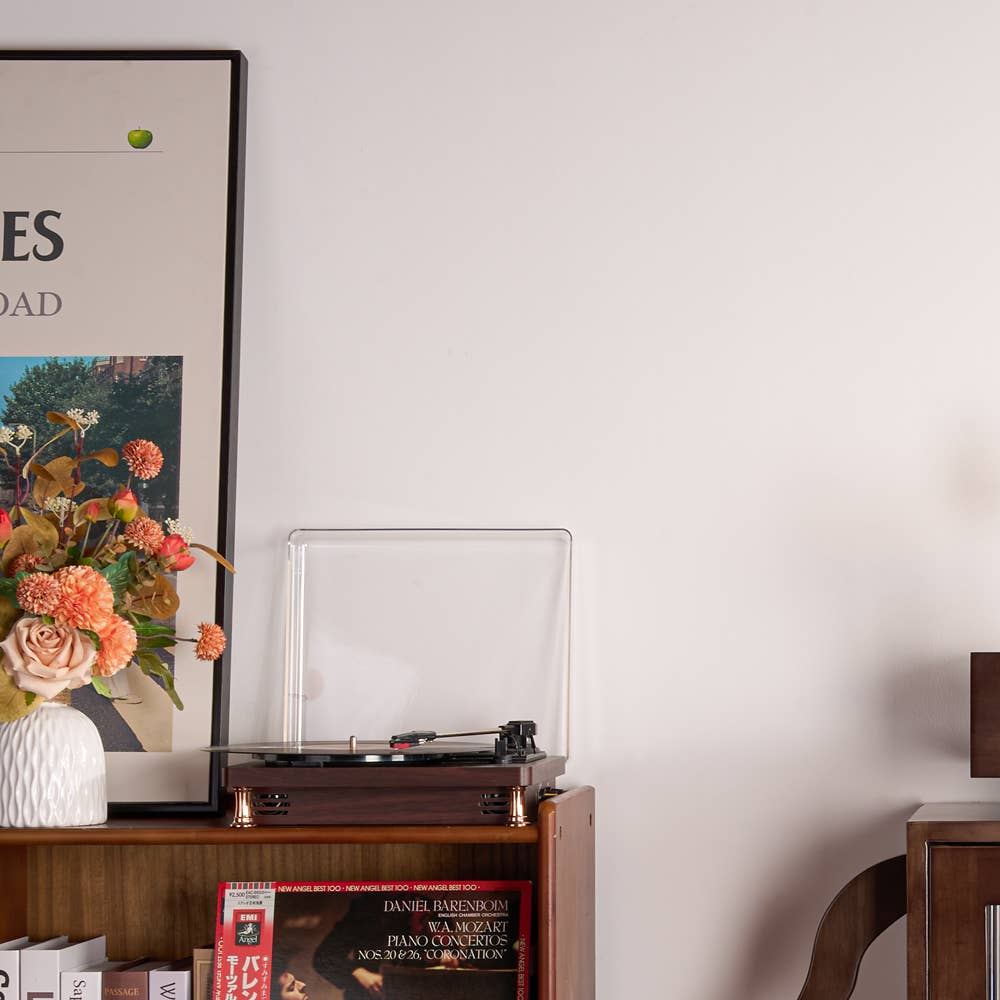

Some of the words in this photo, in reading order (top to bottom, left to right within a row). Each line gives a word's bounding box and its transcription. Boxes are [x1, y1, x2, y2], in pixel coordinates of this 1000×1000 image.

[2, 210, 64, 262] ES
[384, 900, 430, 912] DANIEL
[433, 900, 509, 912] BARENBOIM
[428, 921, 454, 933] W.A.
[456, 921, 508, 933] MOZART
[239, 936, 257, 945] Angel
[388, 935, 428, 947] PIANO
[432, 934, 508, 946] CONCERTOS
[384, 950, 396, 960] 20
[399, 950, 408, 960] &
[104, 987, 140, 996] PASSAGE
